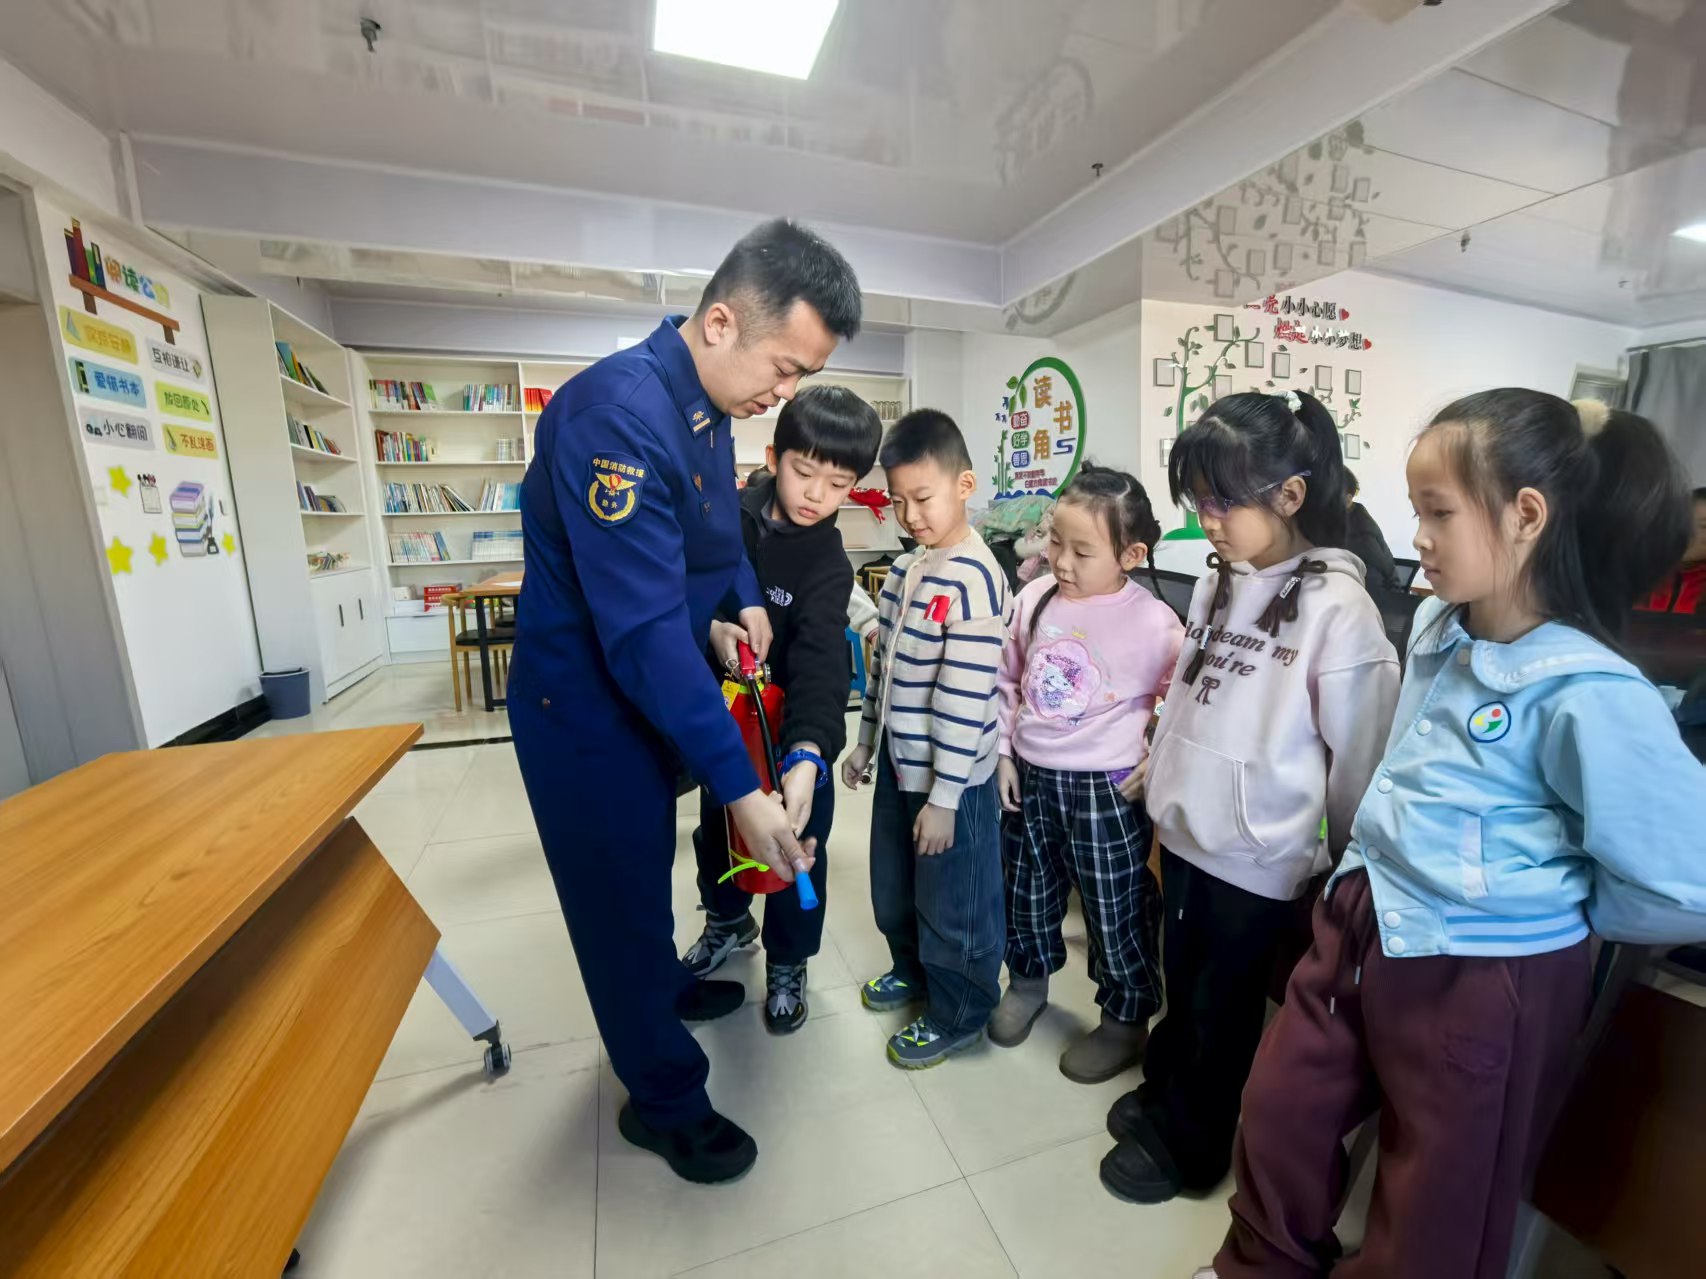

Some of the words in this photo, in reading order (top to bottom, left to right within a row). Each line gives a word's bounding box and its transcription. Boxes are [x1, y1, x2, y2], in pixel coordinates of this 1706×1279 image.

[152, 347, 190, 373] 互相谦让
[94, 371, 140, 398] 爱惜书本
[164, 391, 200, 413] 放回原处
[104, 418, 148, 441] 小心翻阅
[593, 458, 645, 478] 中国消防救援
[1205, 651, 1257, 677] ou're
[1271, 644, 1300, 667] my
